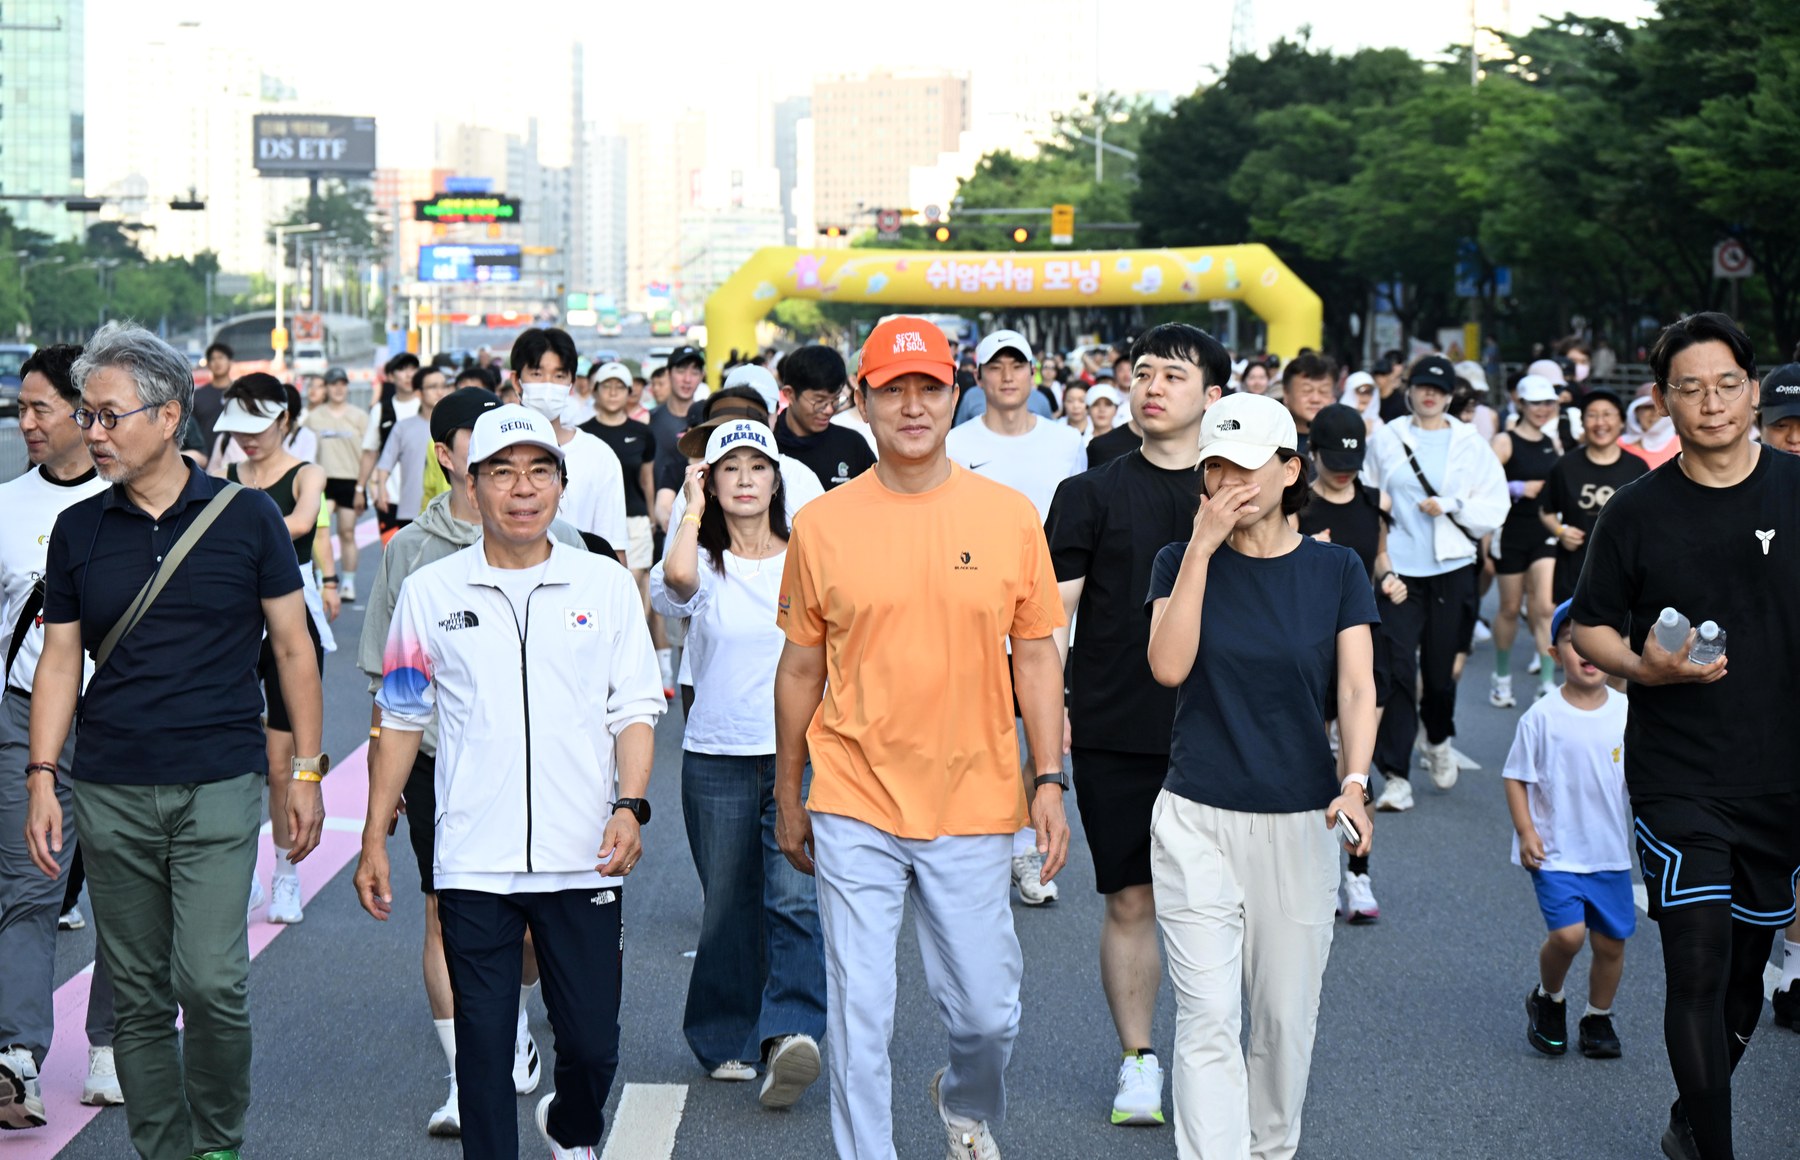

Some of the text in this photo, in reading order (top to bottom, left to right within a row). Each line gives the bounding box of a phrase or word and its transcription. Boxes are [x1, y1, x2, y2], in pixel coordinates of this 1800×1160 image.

[260, 138, 347, 160] DS ETF
[926, 258, 1101, 294] 쉬엄쉬엄 모닝
[906, 340, 928, 352] SOUL
[500, 420, 536, 433] SEOUL
[720, 431, 768, 448] AKARAKA
[449, 611, 464, 620] THE
[438, 616, 464, 628] NORTH
[445, 623, 464, 632] FACE
